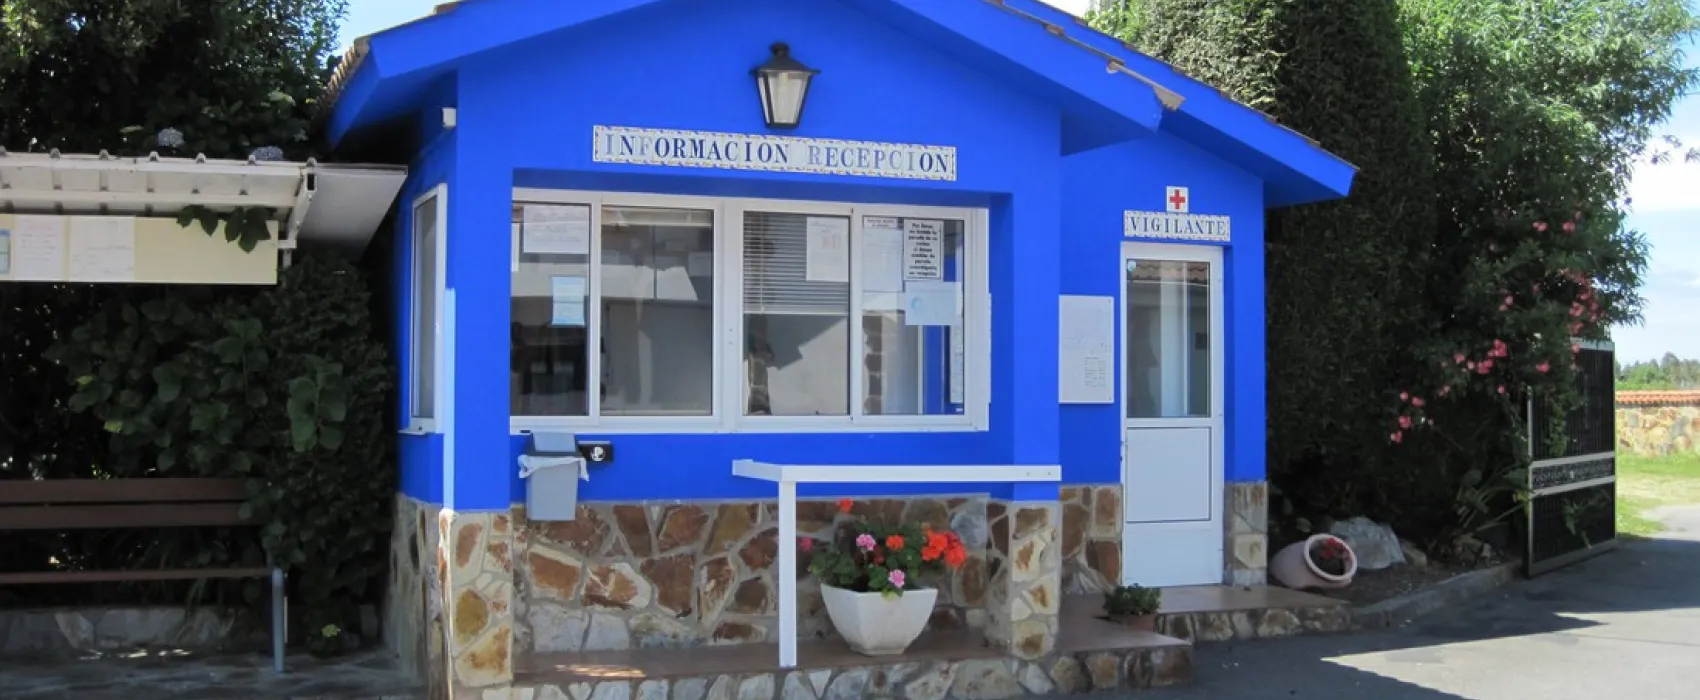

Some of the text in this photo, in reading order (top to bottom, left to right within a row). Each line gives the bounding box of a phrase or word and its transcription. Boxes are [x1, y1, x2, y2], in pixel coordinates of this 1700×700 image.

[605, 133, 949, 173] INFORMACION RECEPCION
[1130, 216, 1225, 235] VIGILANTE
